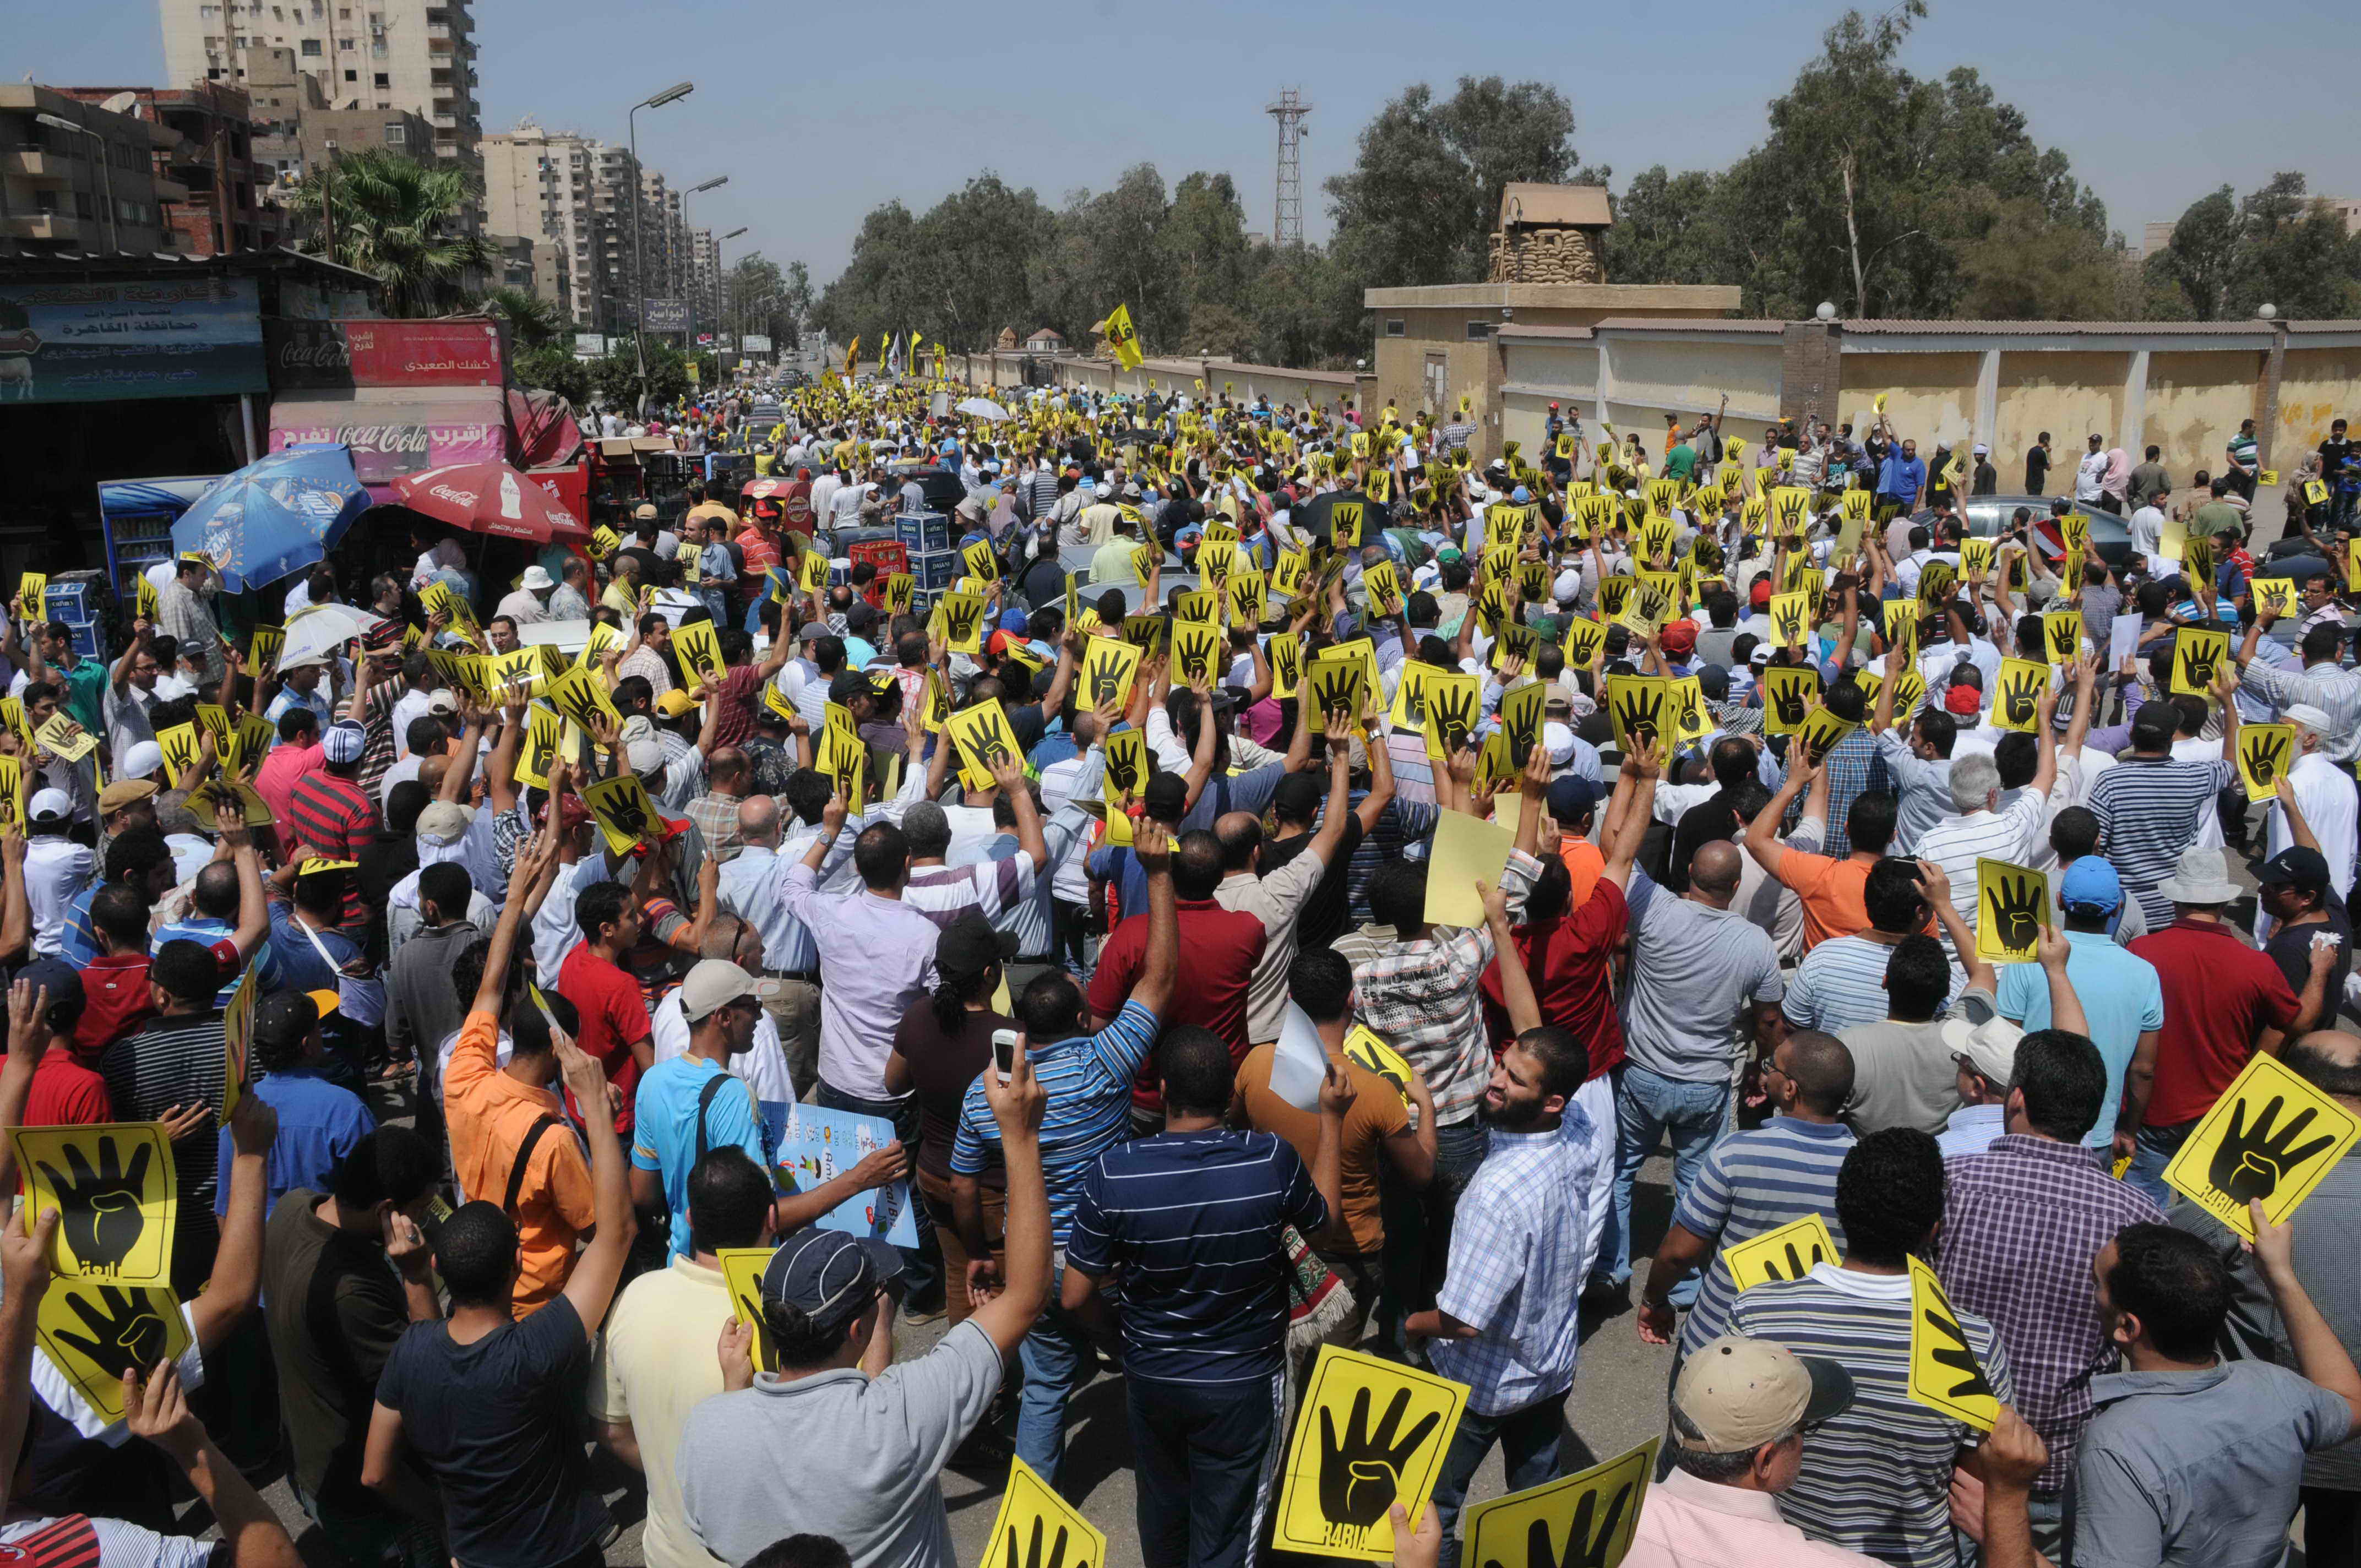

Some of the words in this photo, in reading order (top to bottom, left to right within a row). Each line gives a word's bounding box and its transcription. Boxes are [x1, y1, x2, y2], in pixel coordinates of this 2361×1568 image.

[646, 307, 688, 322] البواسير
[62, 323, 128, 337] القاهرة
[134, 320, 199, 331] محافظة
[353, 342, 374, 351] تفرج
[458, 360, 491, 369] كشك
[335, 421, 428, 453] Coca-Cola
[431, 422, 487, 447] إشرب
[429, 484, 479, 507] Coca-Cola
[546, 510, 576, 526] Coca-Cola
[2200, 1182, 2242, 1218] R4BIA
[1322, 1520, 1370, 1551] R4BIA
